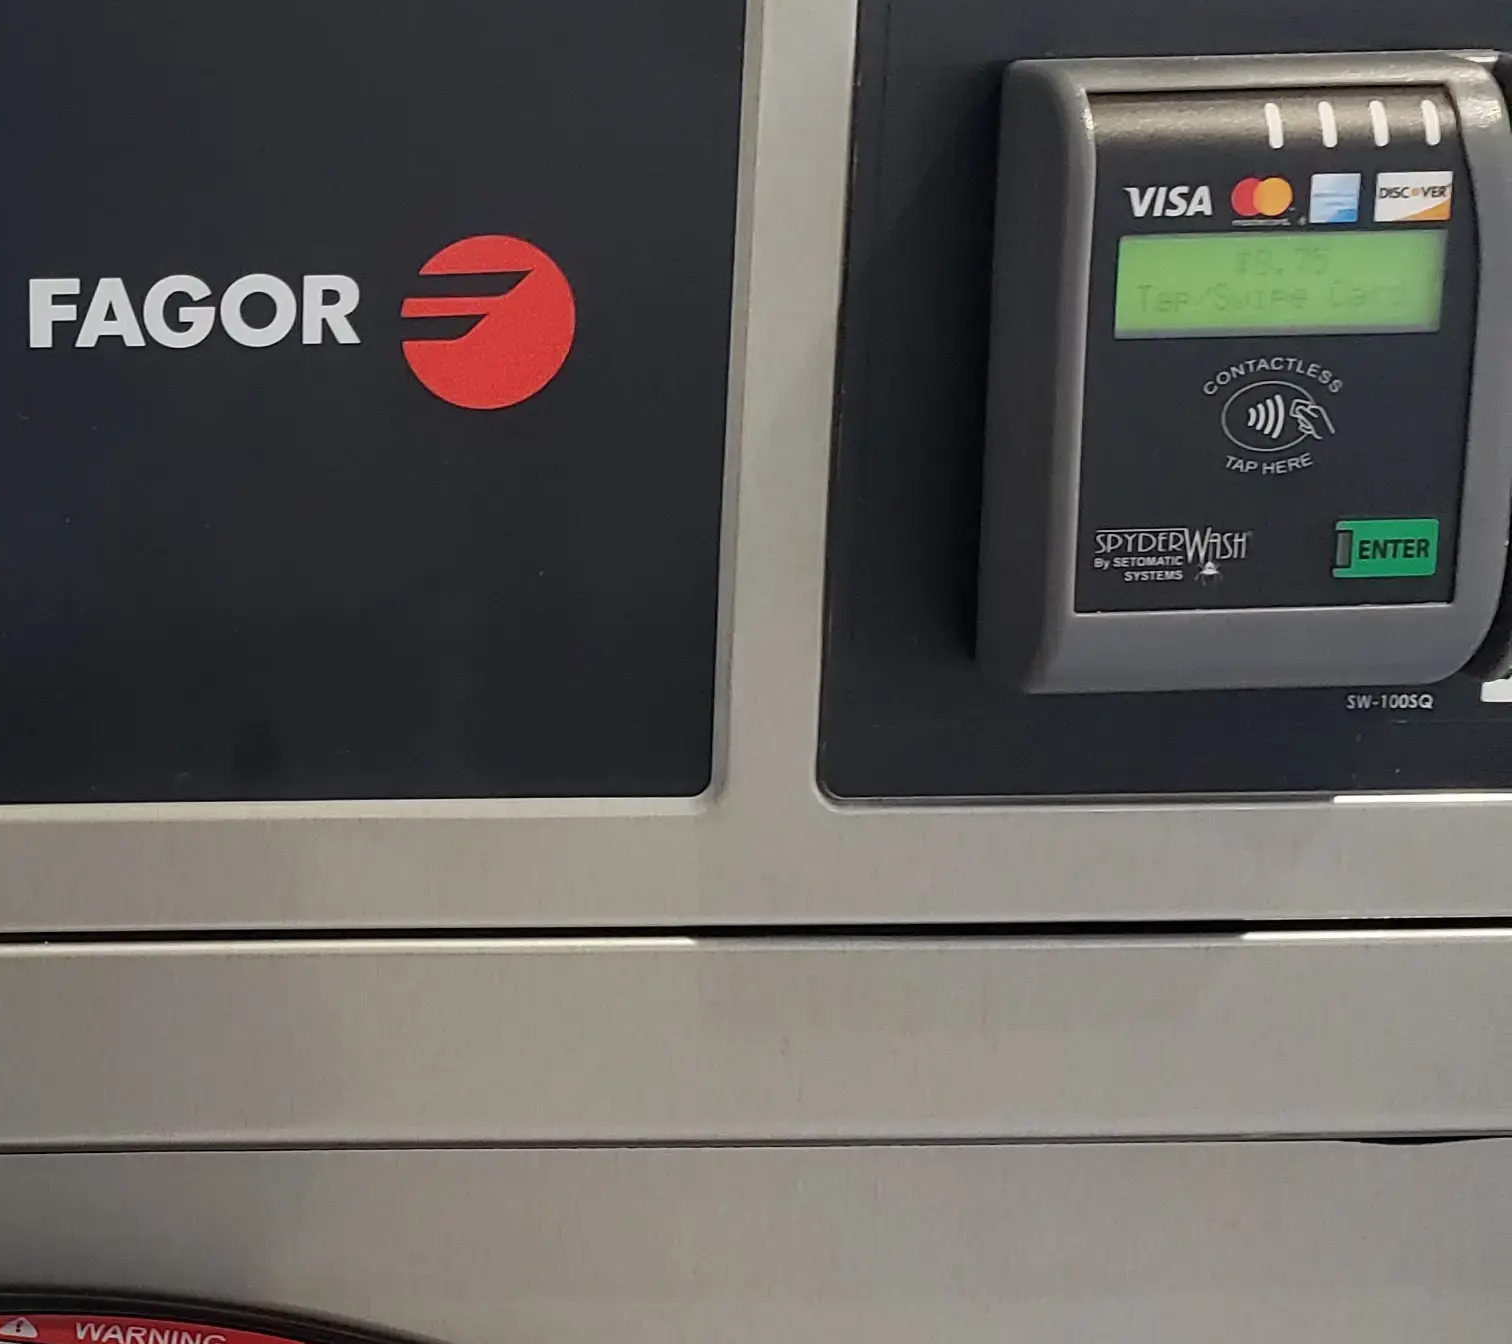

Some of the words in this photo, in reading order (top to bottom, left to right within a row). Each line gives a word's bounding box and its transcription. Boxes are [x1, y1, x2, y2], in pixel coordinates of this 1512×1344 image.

[1124, 185, 1214, 217] VISA
[28, 272, 362, 349] FAGOR
[1202, 356, 1344, 396] CONTACTLESS
[1224, 455, 1259, 474] TAP
[1261, 452, 1314, 476] HERE
[1357, 538, 1431, 560] ENTER
[1093, 557, 1110, 569] By
[1112, 555, 1184, 568] SETOMATIC
[1123, 569, 1184, 582] SYSTEMS
[1345, 693, 1434, 710] SW-100SQ
